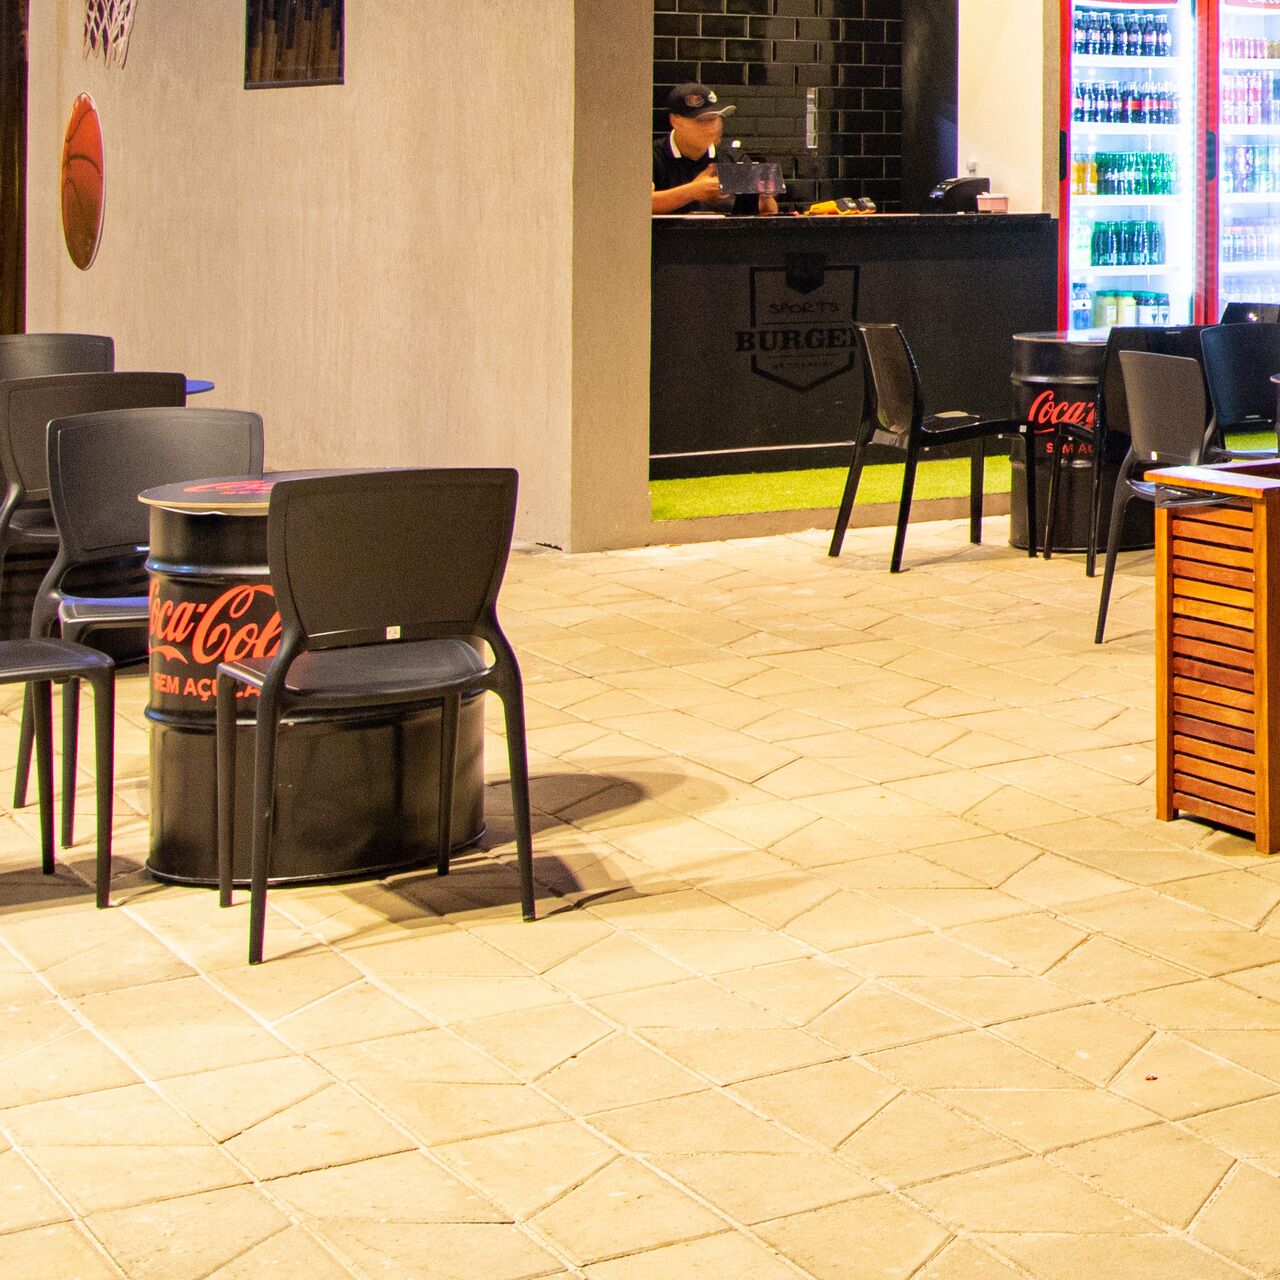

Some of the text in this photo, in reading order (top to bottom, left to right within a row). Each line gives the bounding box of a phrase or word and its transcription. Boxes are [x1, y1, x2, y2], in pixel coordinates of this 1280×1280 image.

[768, 302, 841, 314] SPORTS
[1045, 442, 1075, 454] SM
[149, 573, 283, 665] oca-Col
